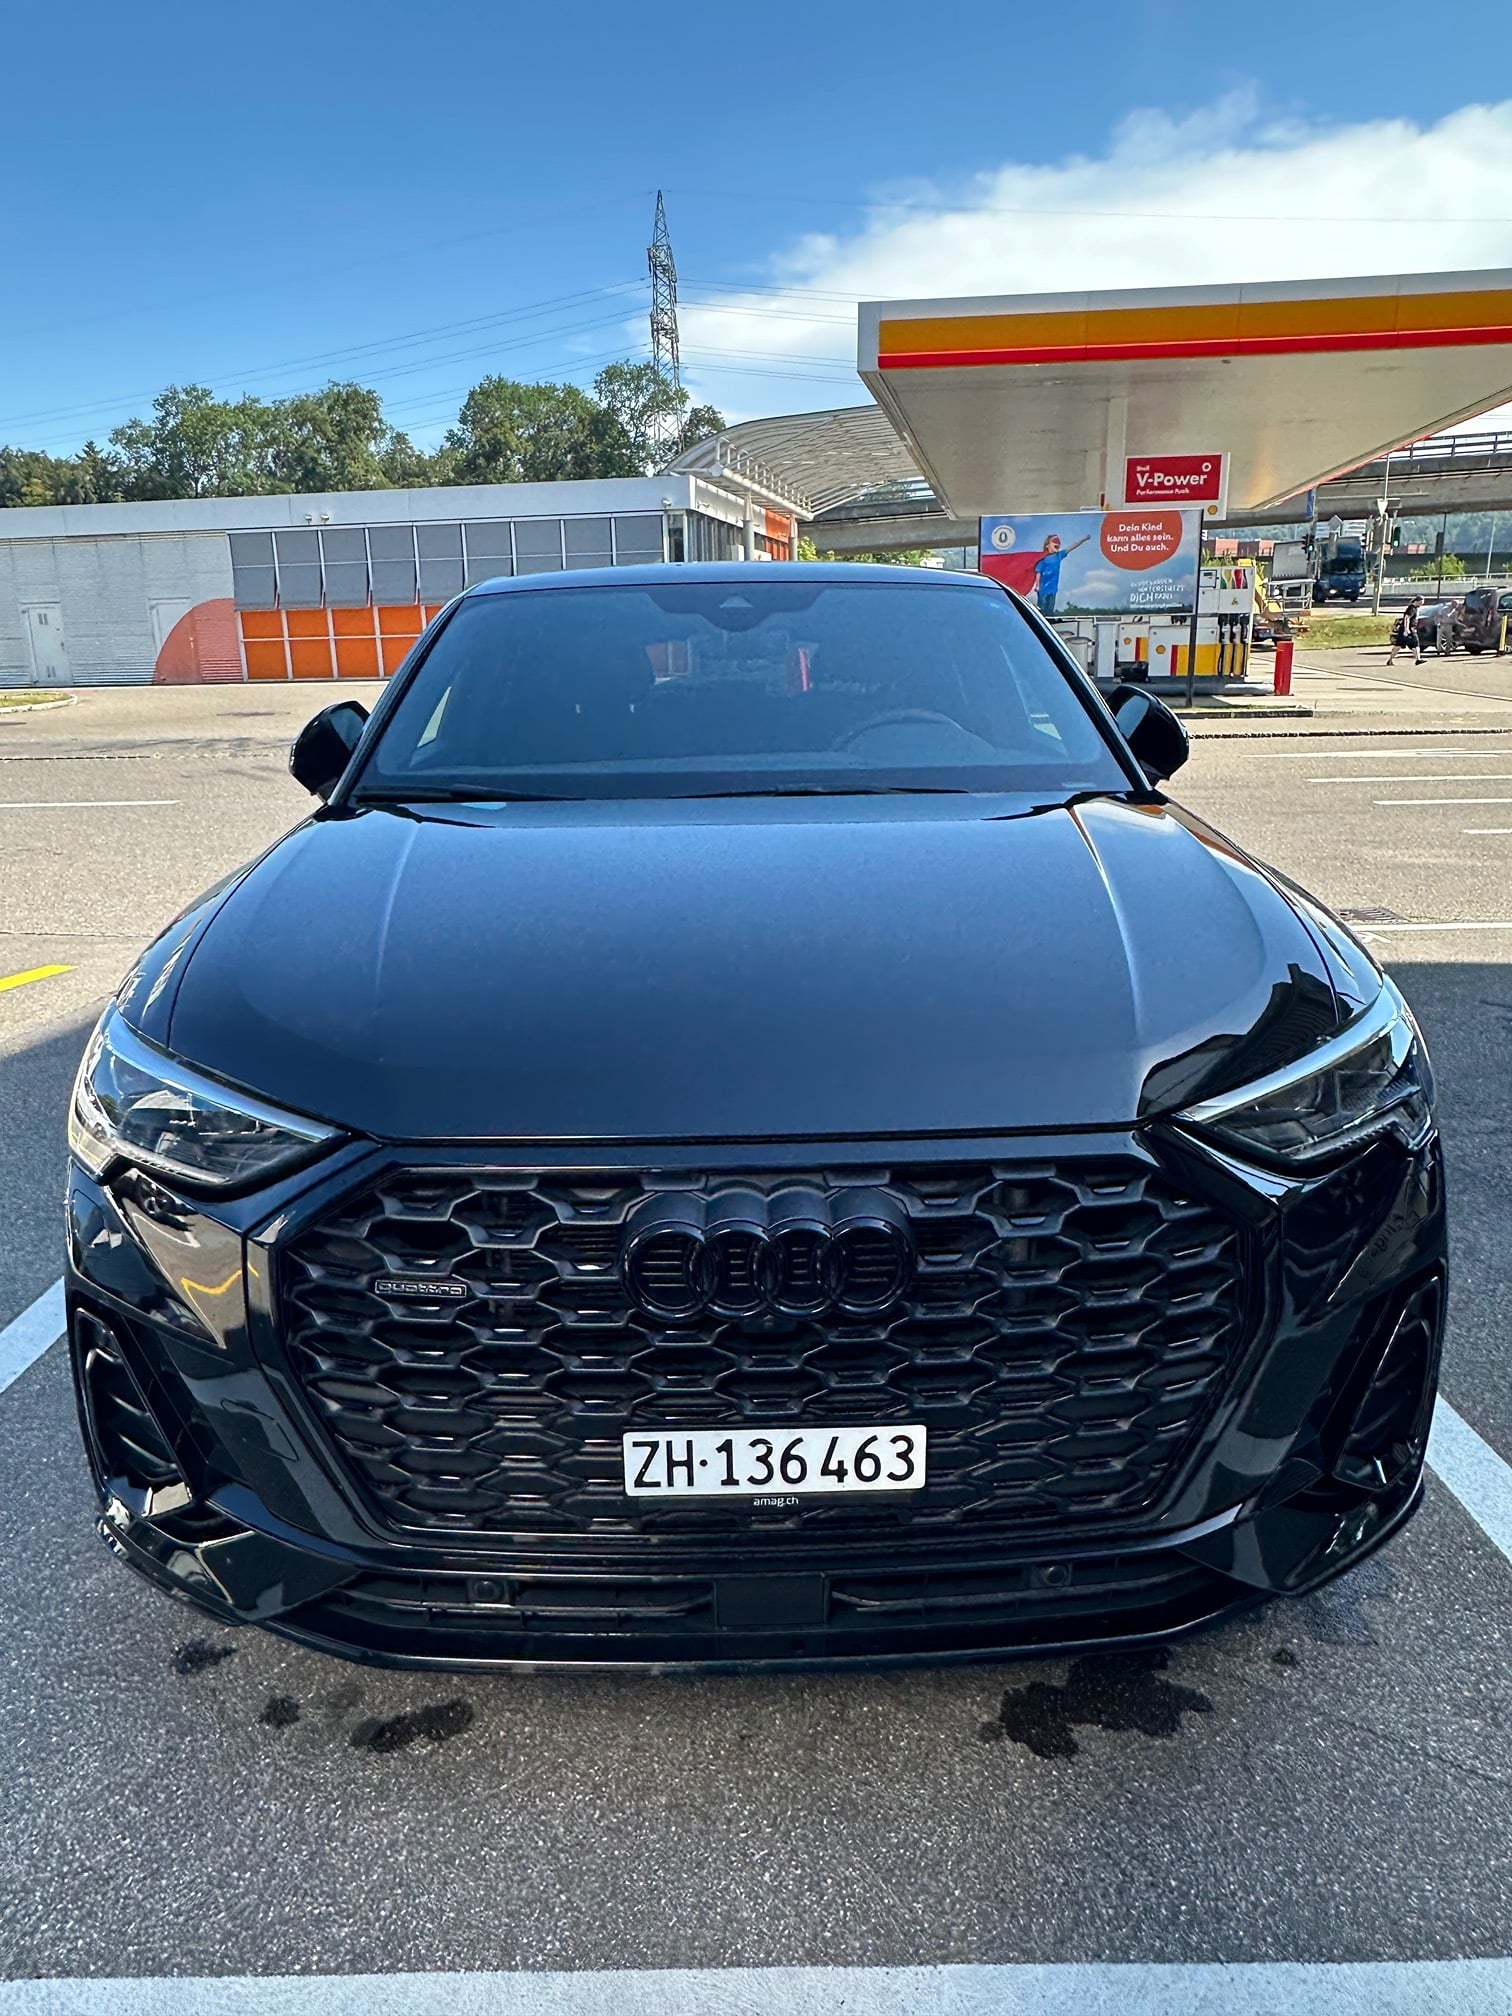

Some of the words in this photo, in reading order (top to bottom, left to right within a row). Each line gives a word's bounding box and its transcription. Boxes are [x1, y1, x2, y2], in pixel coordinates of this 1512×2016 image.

[1136, 472, 1208, 487] V-Power
[1118, 523, 1140, 532] Dein
[1141, 522, 1163, 531] Kind
[1107, 534, 1129, 542] kann
[1110, 544, 1129, 552] Und
[1130, 543, 1144, 552] Du
[379, 1282, 462, 1295] quattro
